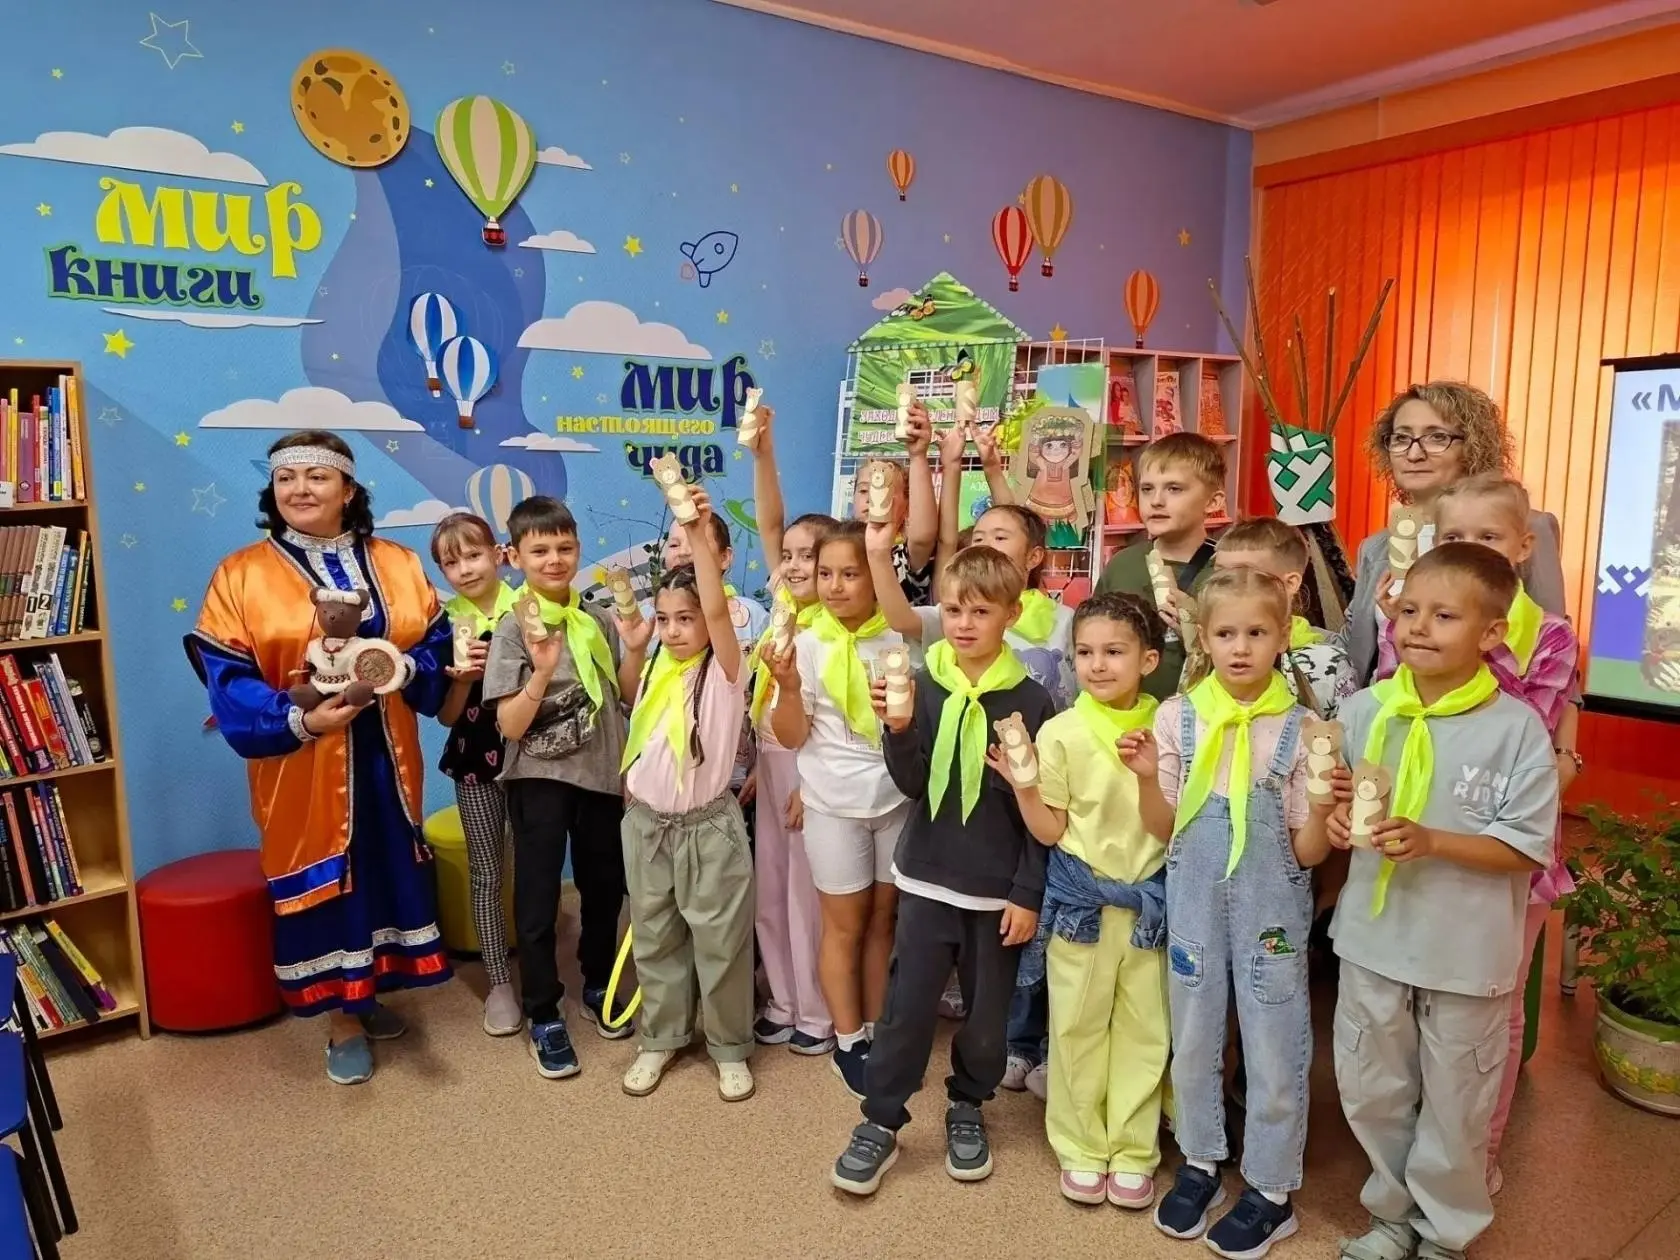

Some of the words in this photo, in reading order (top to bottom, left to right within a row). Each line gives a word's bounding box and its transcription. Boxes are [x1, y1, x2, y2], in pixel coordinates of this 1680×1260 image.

[48, 245, 261, 307] книги
[556, 415, 716, 435] настоящего
[1462, 765, 1509, 792] VAN
